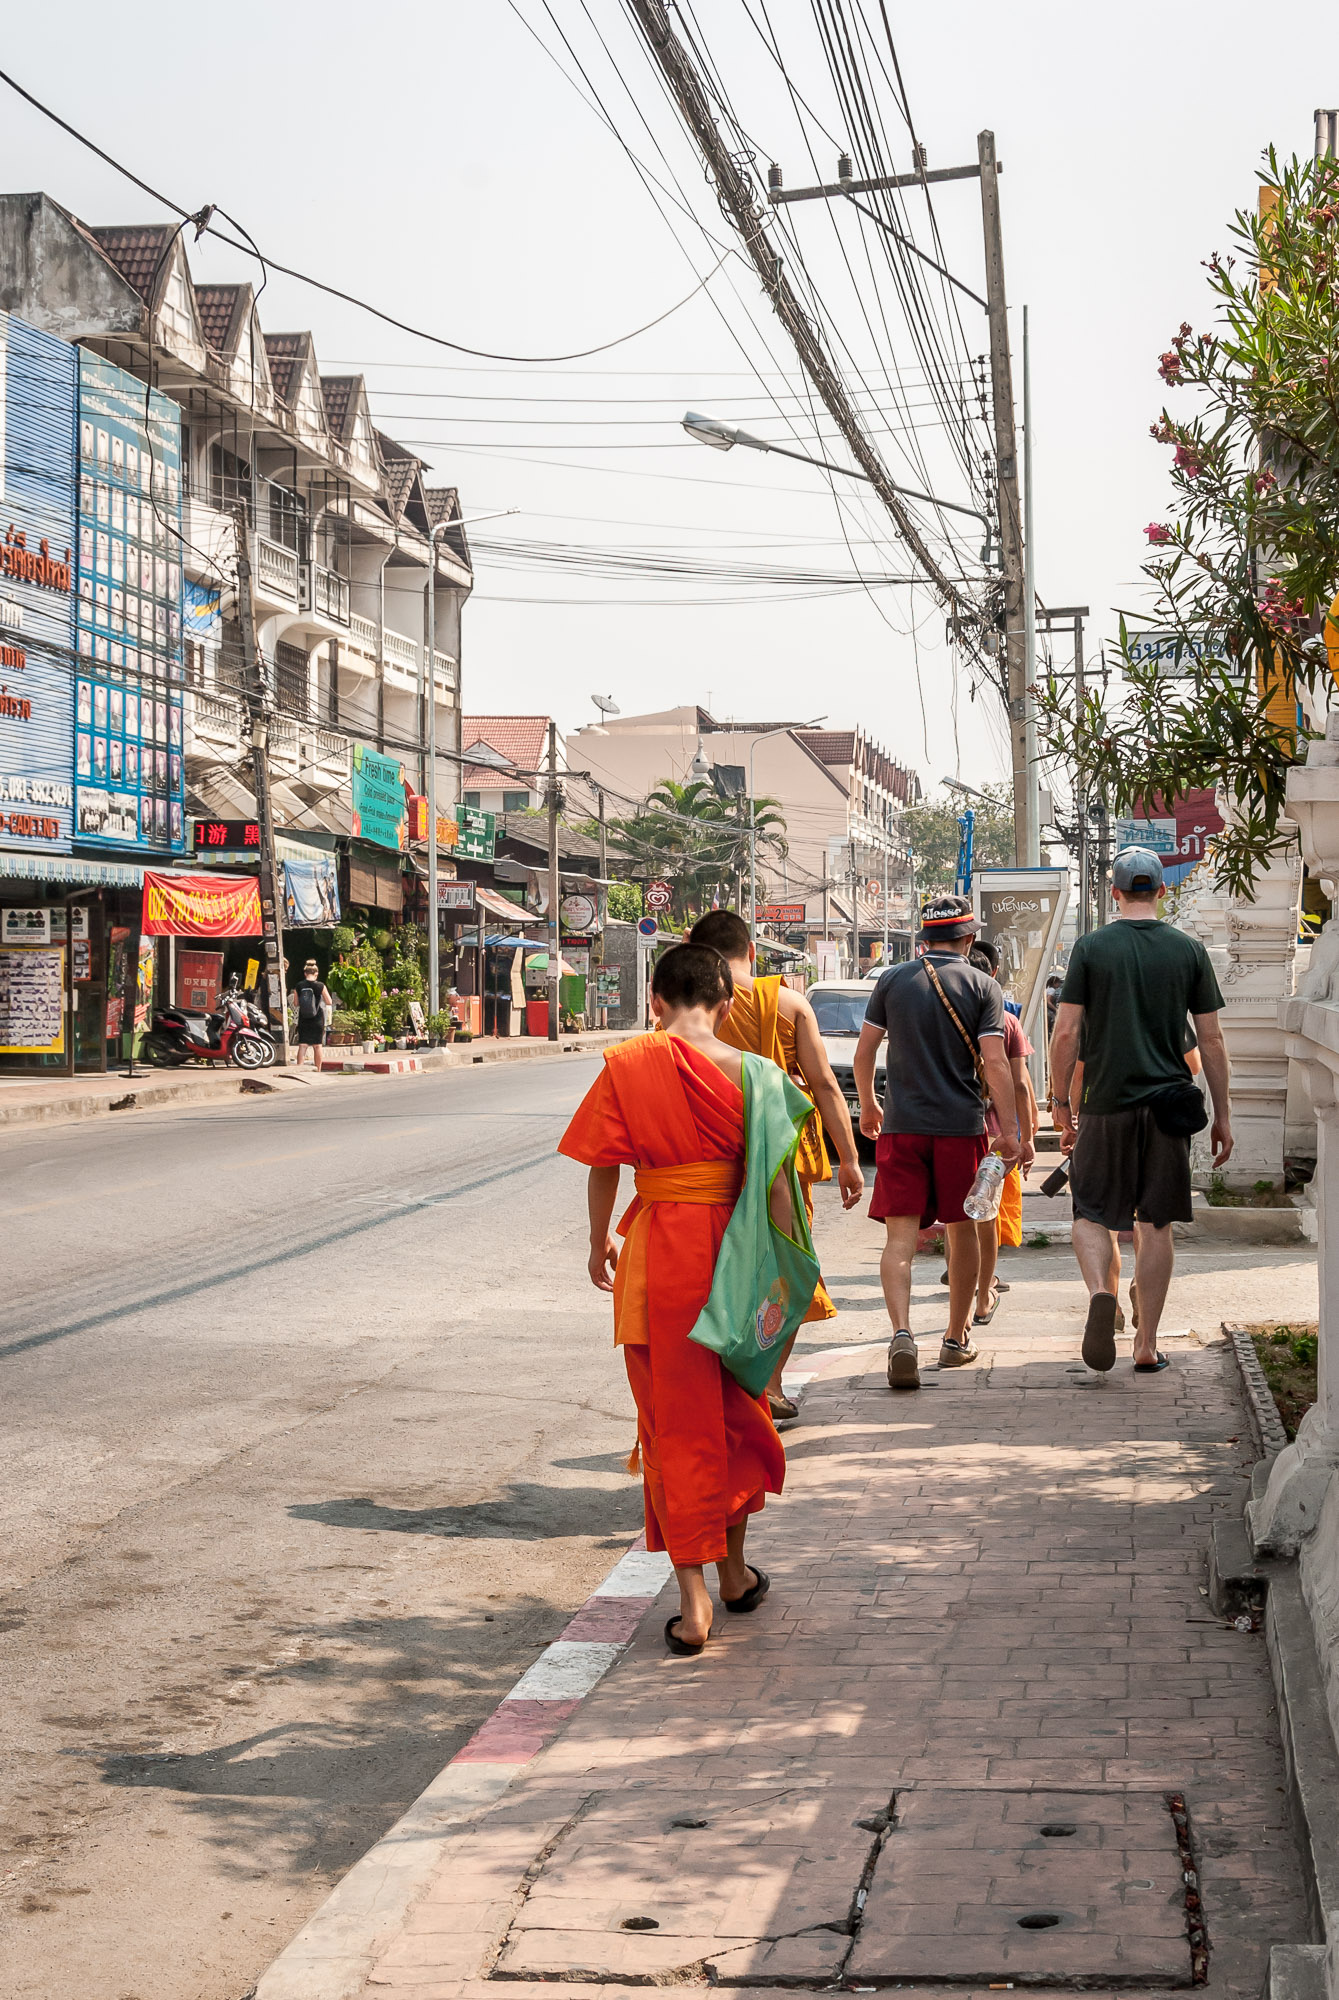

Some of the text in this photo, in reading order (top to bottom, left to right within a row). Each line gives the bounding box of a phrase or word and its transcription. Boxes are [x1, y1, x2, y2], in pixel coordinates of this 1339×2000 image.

[364, 756, 382, 780] Fresh
[148, 887, 168, 921] ONE
[775, 908, 782, 920] 2
[922, 908, 962, 920] ellesse
